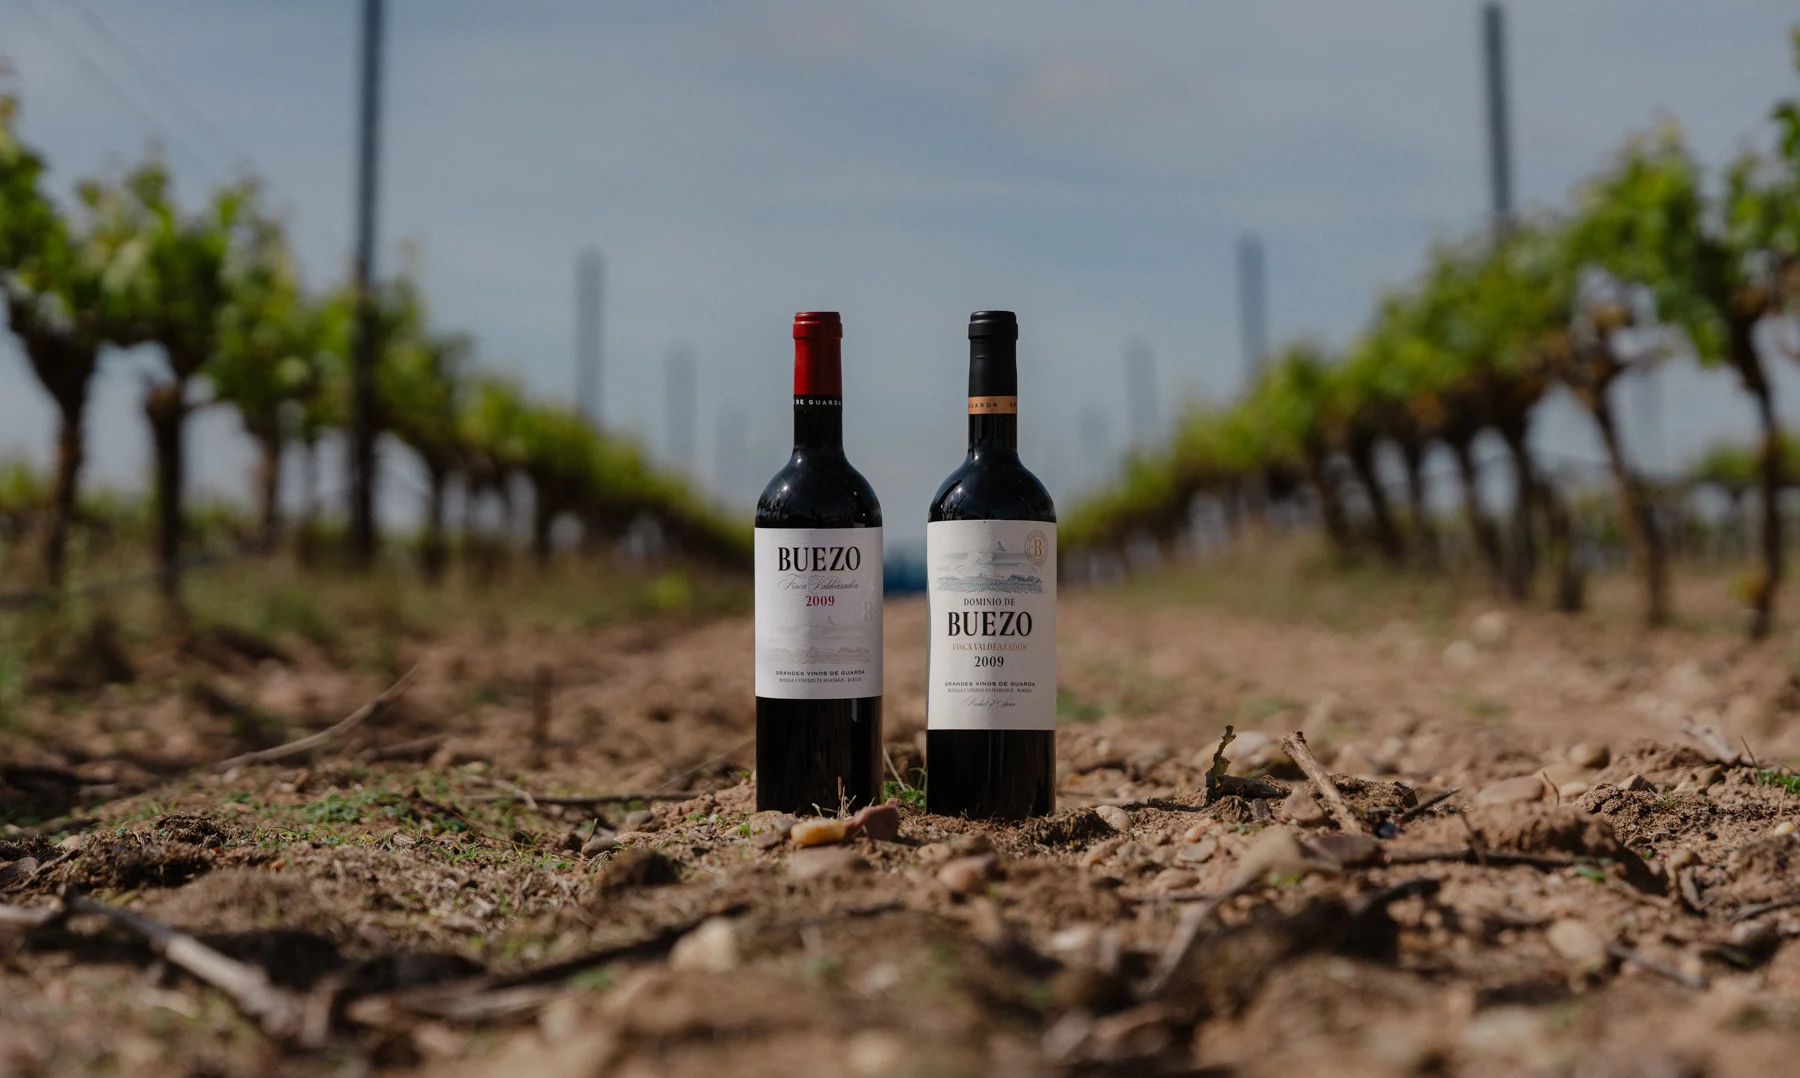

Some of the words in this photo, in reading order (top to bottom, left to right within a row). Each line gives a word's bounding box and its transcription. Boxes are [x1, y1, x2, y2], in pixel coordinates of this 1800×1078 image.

[778, 546, 861, 571] BUEZO
[805, 595, 835, 607] 2009
[963, 598, 1002, 606] DOMINIO
[1004, 598, 1016, 606] DE
[947, 611, 1032, 637] BUEZO
[952, 643, 973, 651] FINCA
[974, 655, 1005, 667] 2009
